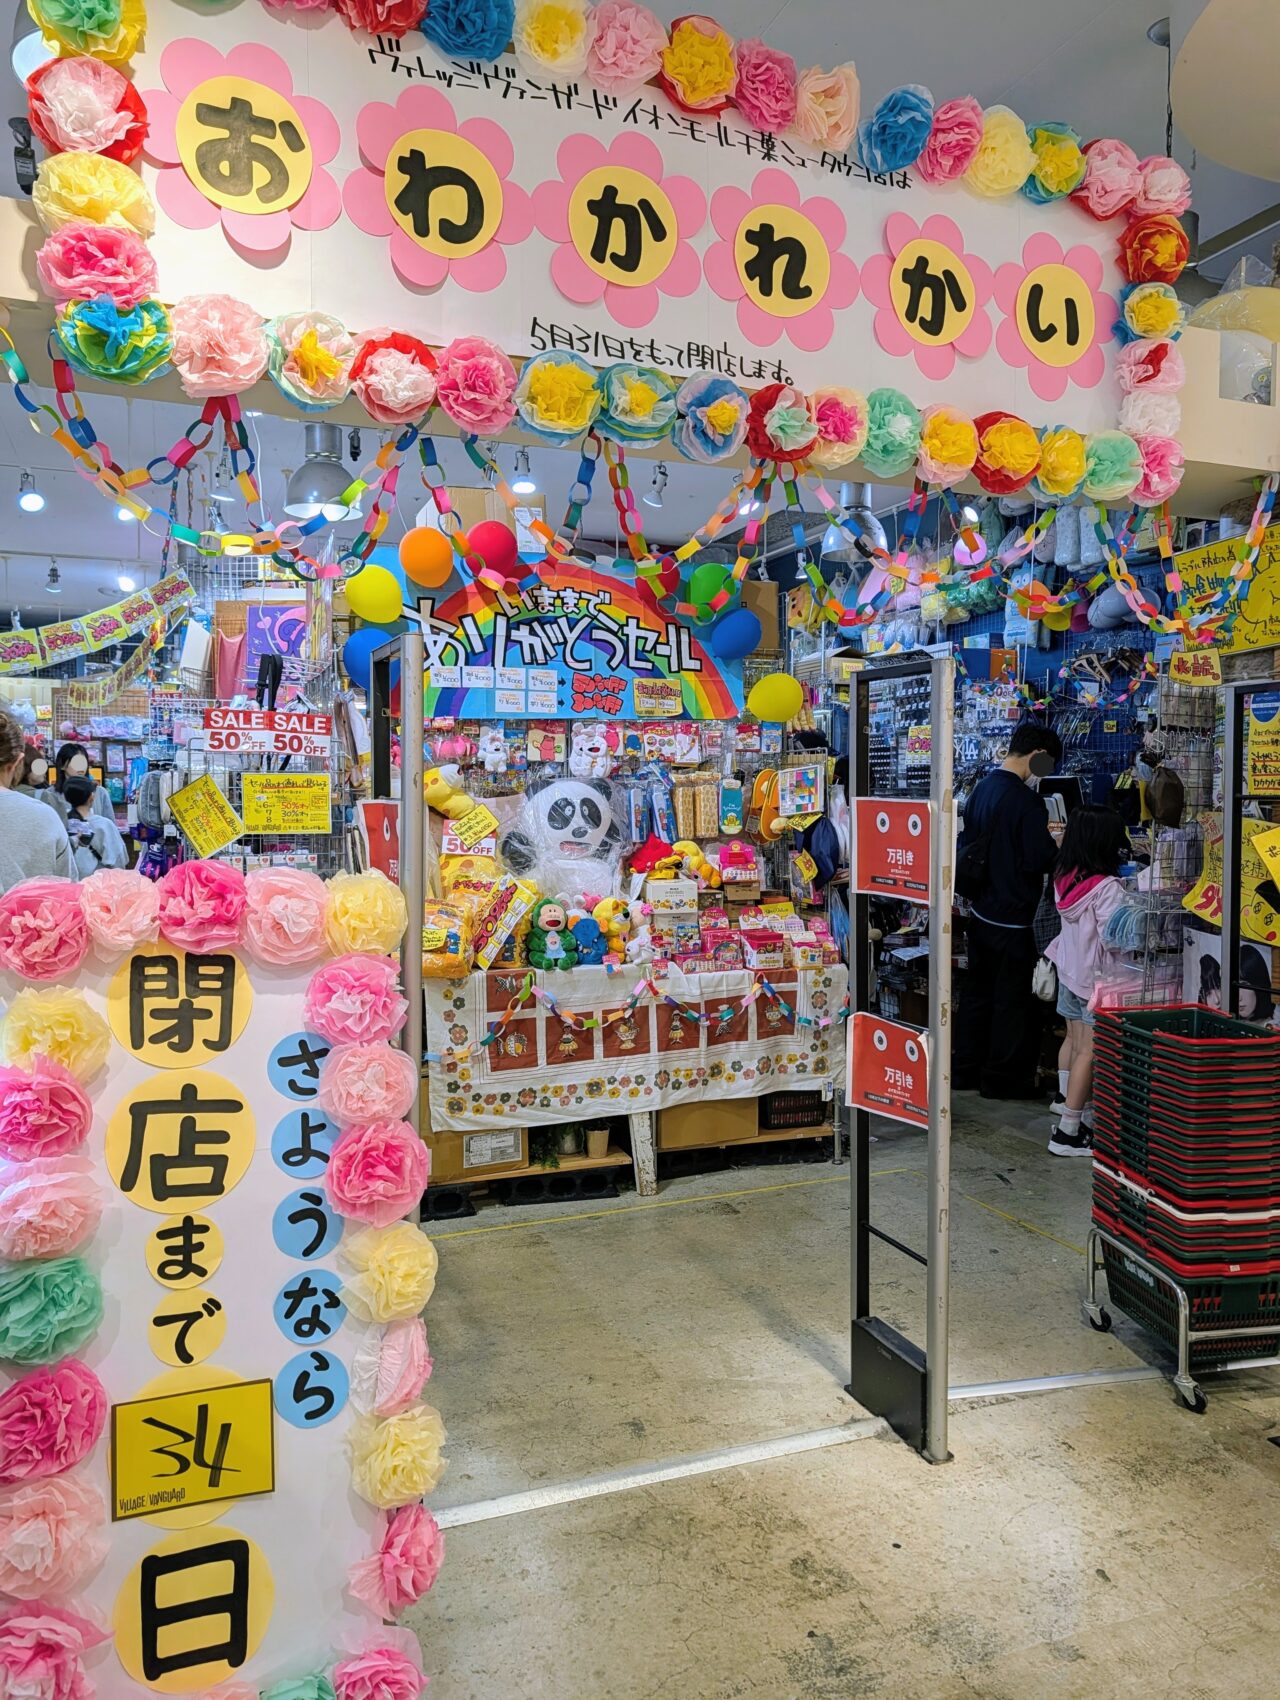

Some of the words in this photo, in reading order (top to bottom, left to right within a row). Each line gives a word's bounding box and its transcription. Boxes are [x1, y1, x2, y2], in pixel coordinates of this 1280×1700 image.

[368, 35, 618, 119] ヴィレッジヴァンガード
[195, 96, 1080, 346] おわかれかい
[530, 315, 794, 387] 5月31日をもって閉店します。
[402, 596, 703, 673] ありがとうセール
[210, 710, 265, 729] SALE
[274, 714, 327, 733] SALE
[304, 745, 327, 755] OFF
[473, 846, 493, 855] OFF
[886, 848, 914, 866] 万引き
[884, 1066, 914, 1090] 万引き
[277, 1039, 341, 1421] さようなら
